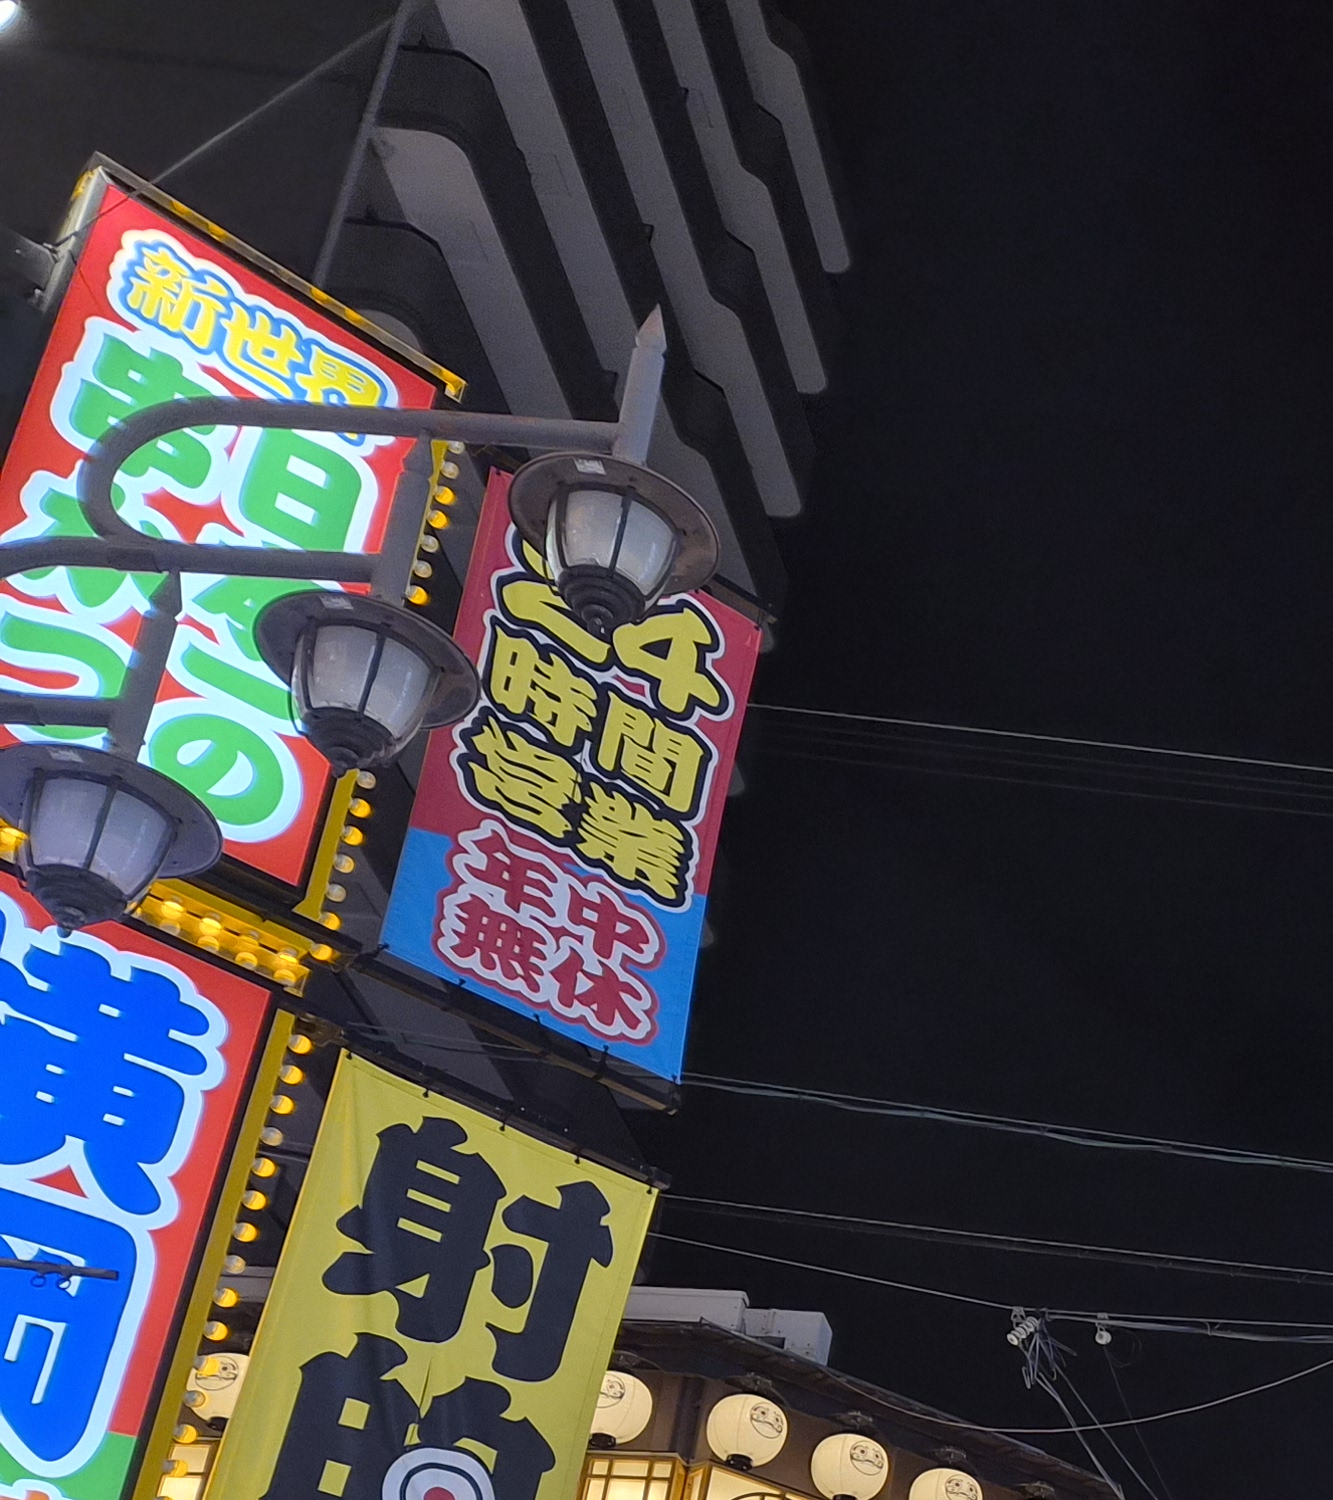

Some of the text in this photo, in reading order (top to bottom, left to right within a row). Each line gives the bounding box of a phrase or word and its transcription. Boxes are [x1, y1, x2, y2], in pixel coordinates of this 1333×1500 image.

[122, 240, 390, 442] 新世界
[468, 715, 688, 902] 営業
[490, 625, 705, 813] 時間
[450, 900, 645, 1032] 無休
[463, 828, 653, 960] 年中
